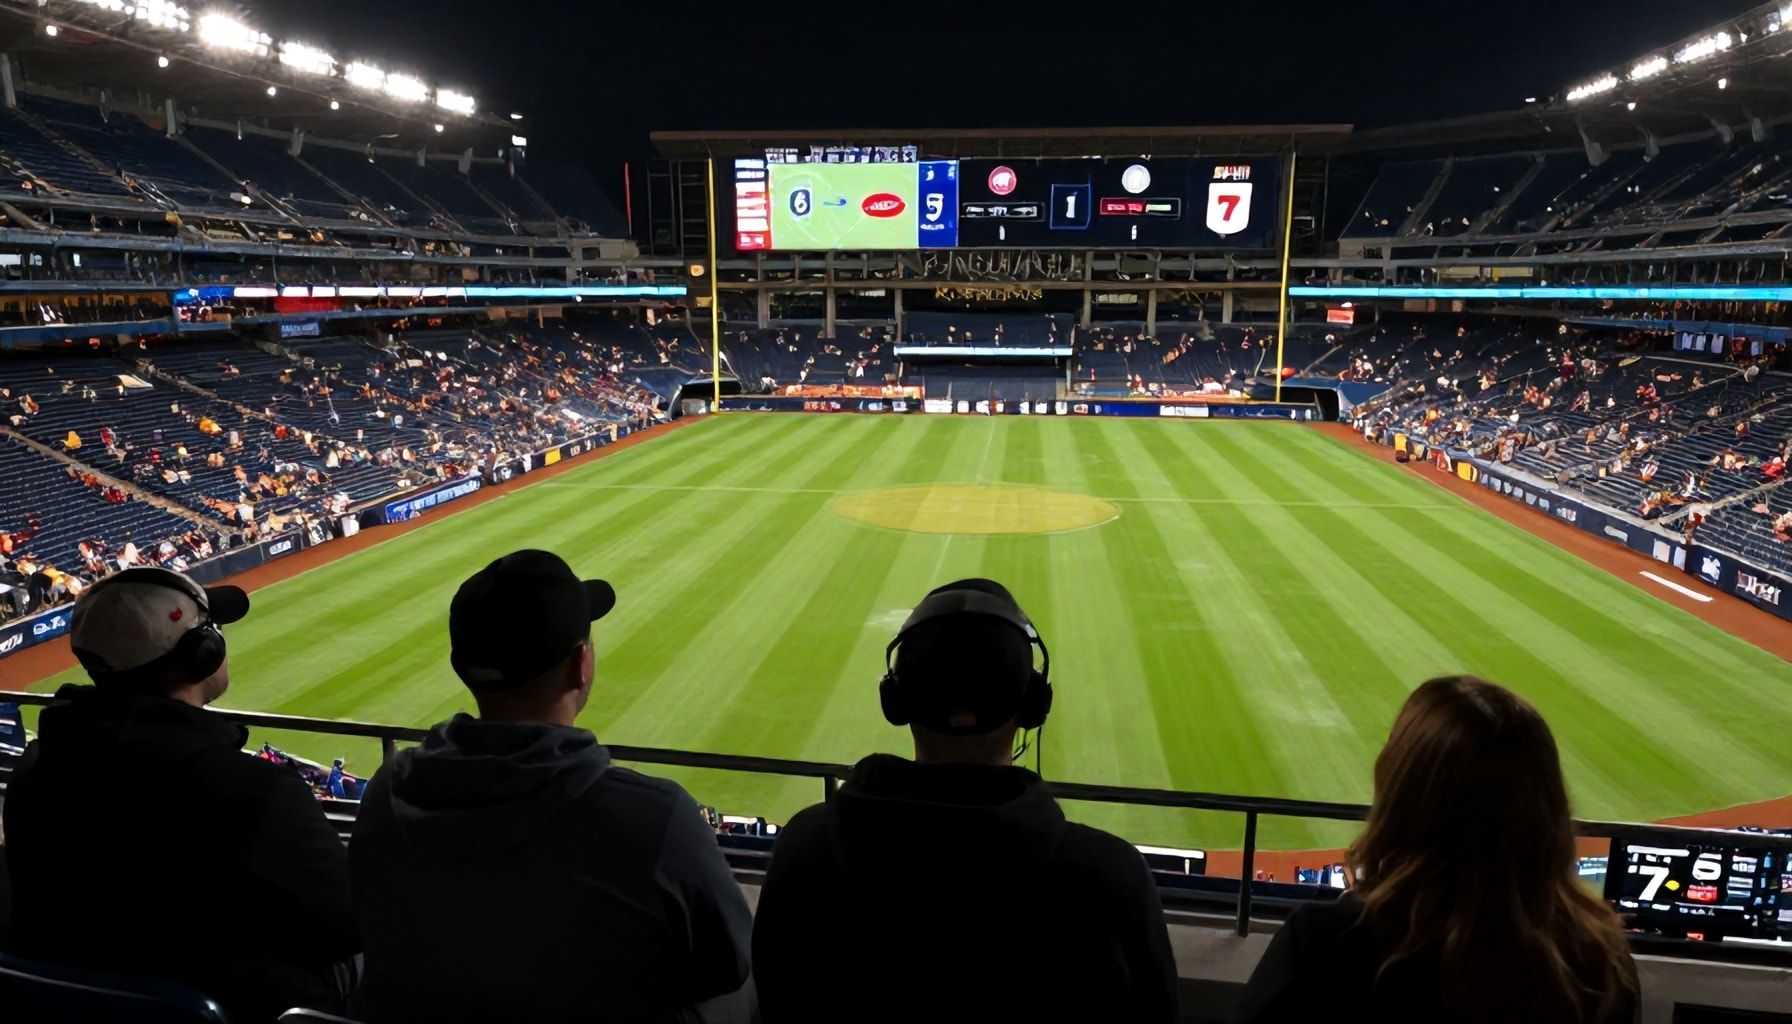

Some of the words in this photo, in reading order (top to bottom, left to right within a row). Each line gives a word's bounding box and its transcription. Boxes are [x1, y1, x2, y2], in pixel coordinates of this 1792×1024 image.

[793, 190, 809, 214] 6
[1066, 195, 1076, 218] 1
[1218, 195, 1241, 221] 7
[1692, 852, 1722, 880] 6
[1639, 865, 1670, 901] 7
